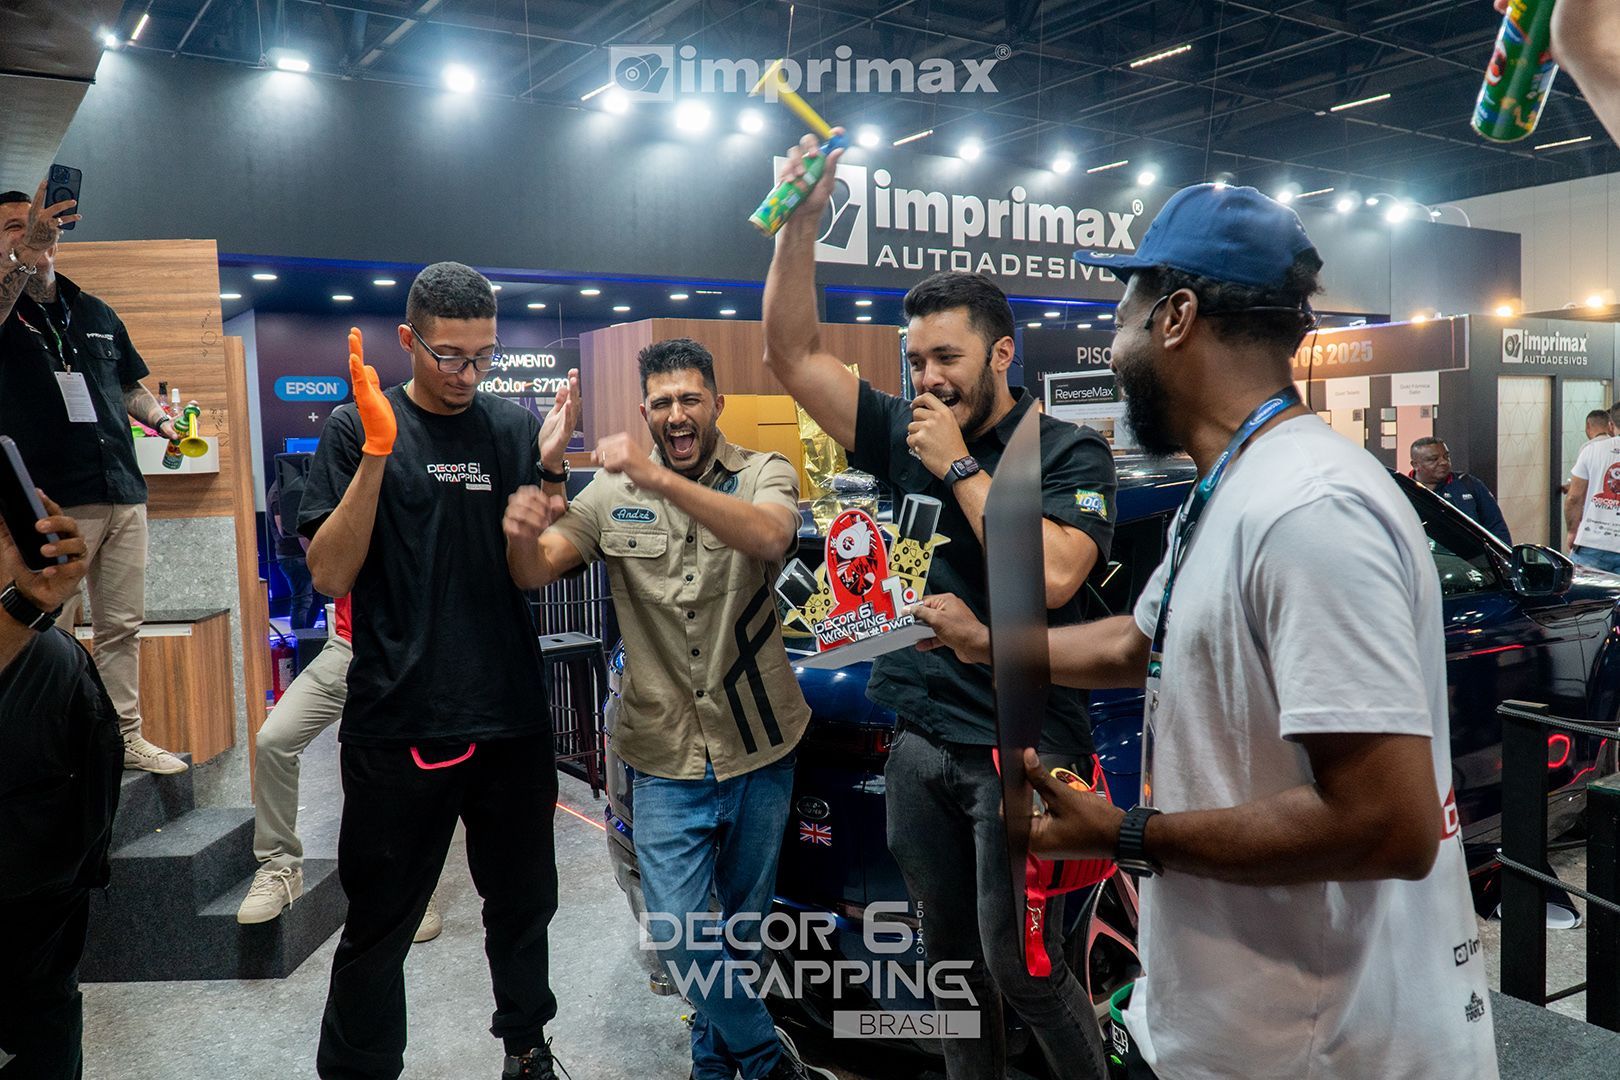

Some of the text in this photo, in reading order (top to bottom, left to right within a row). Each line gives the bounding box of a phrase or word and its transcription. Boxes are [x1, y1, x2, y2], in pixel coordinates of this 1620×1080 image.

[1326, 340, 1373, 365] 2025
[1523, 355, 1588, 365] AUTOADESIVOS
[285, 382, 338, 395] EPSON
[1055, 386, 1114, 400] ReverseMax
[426, 463, 467, 474] DECOR
[434, 472, 491, 485] WRAPPING
[813, 603, 872, 635] DECOR 6
[818, 612, 887, 645] WRAPPING
